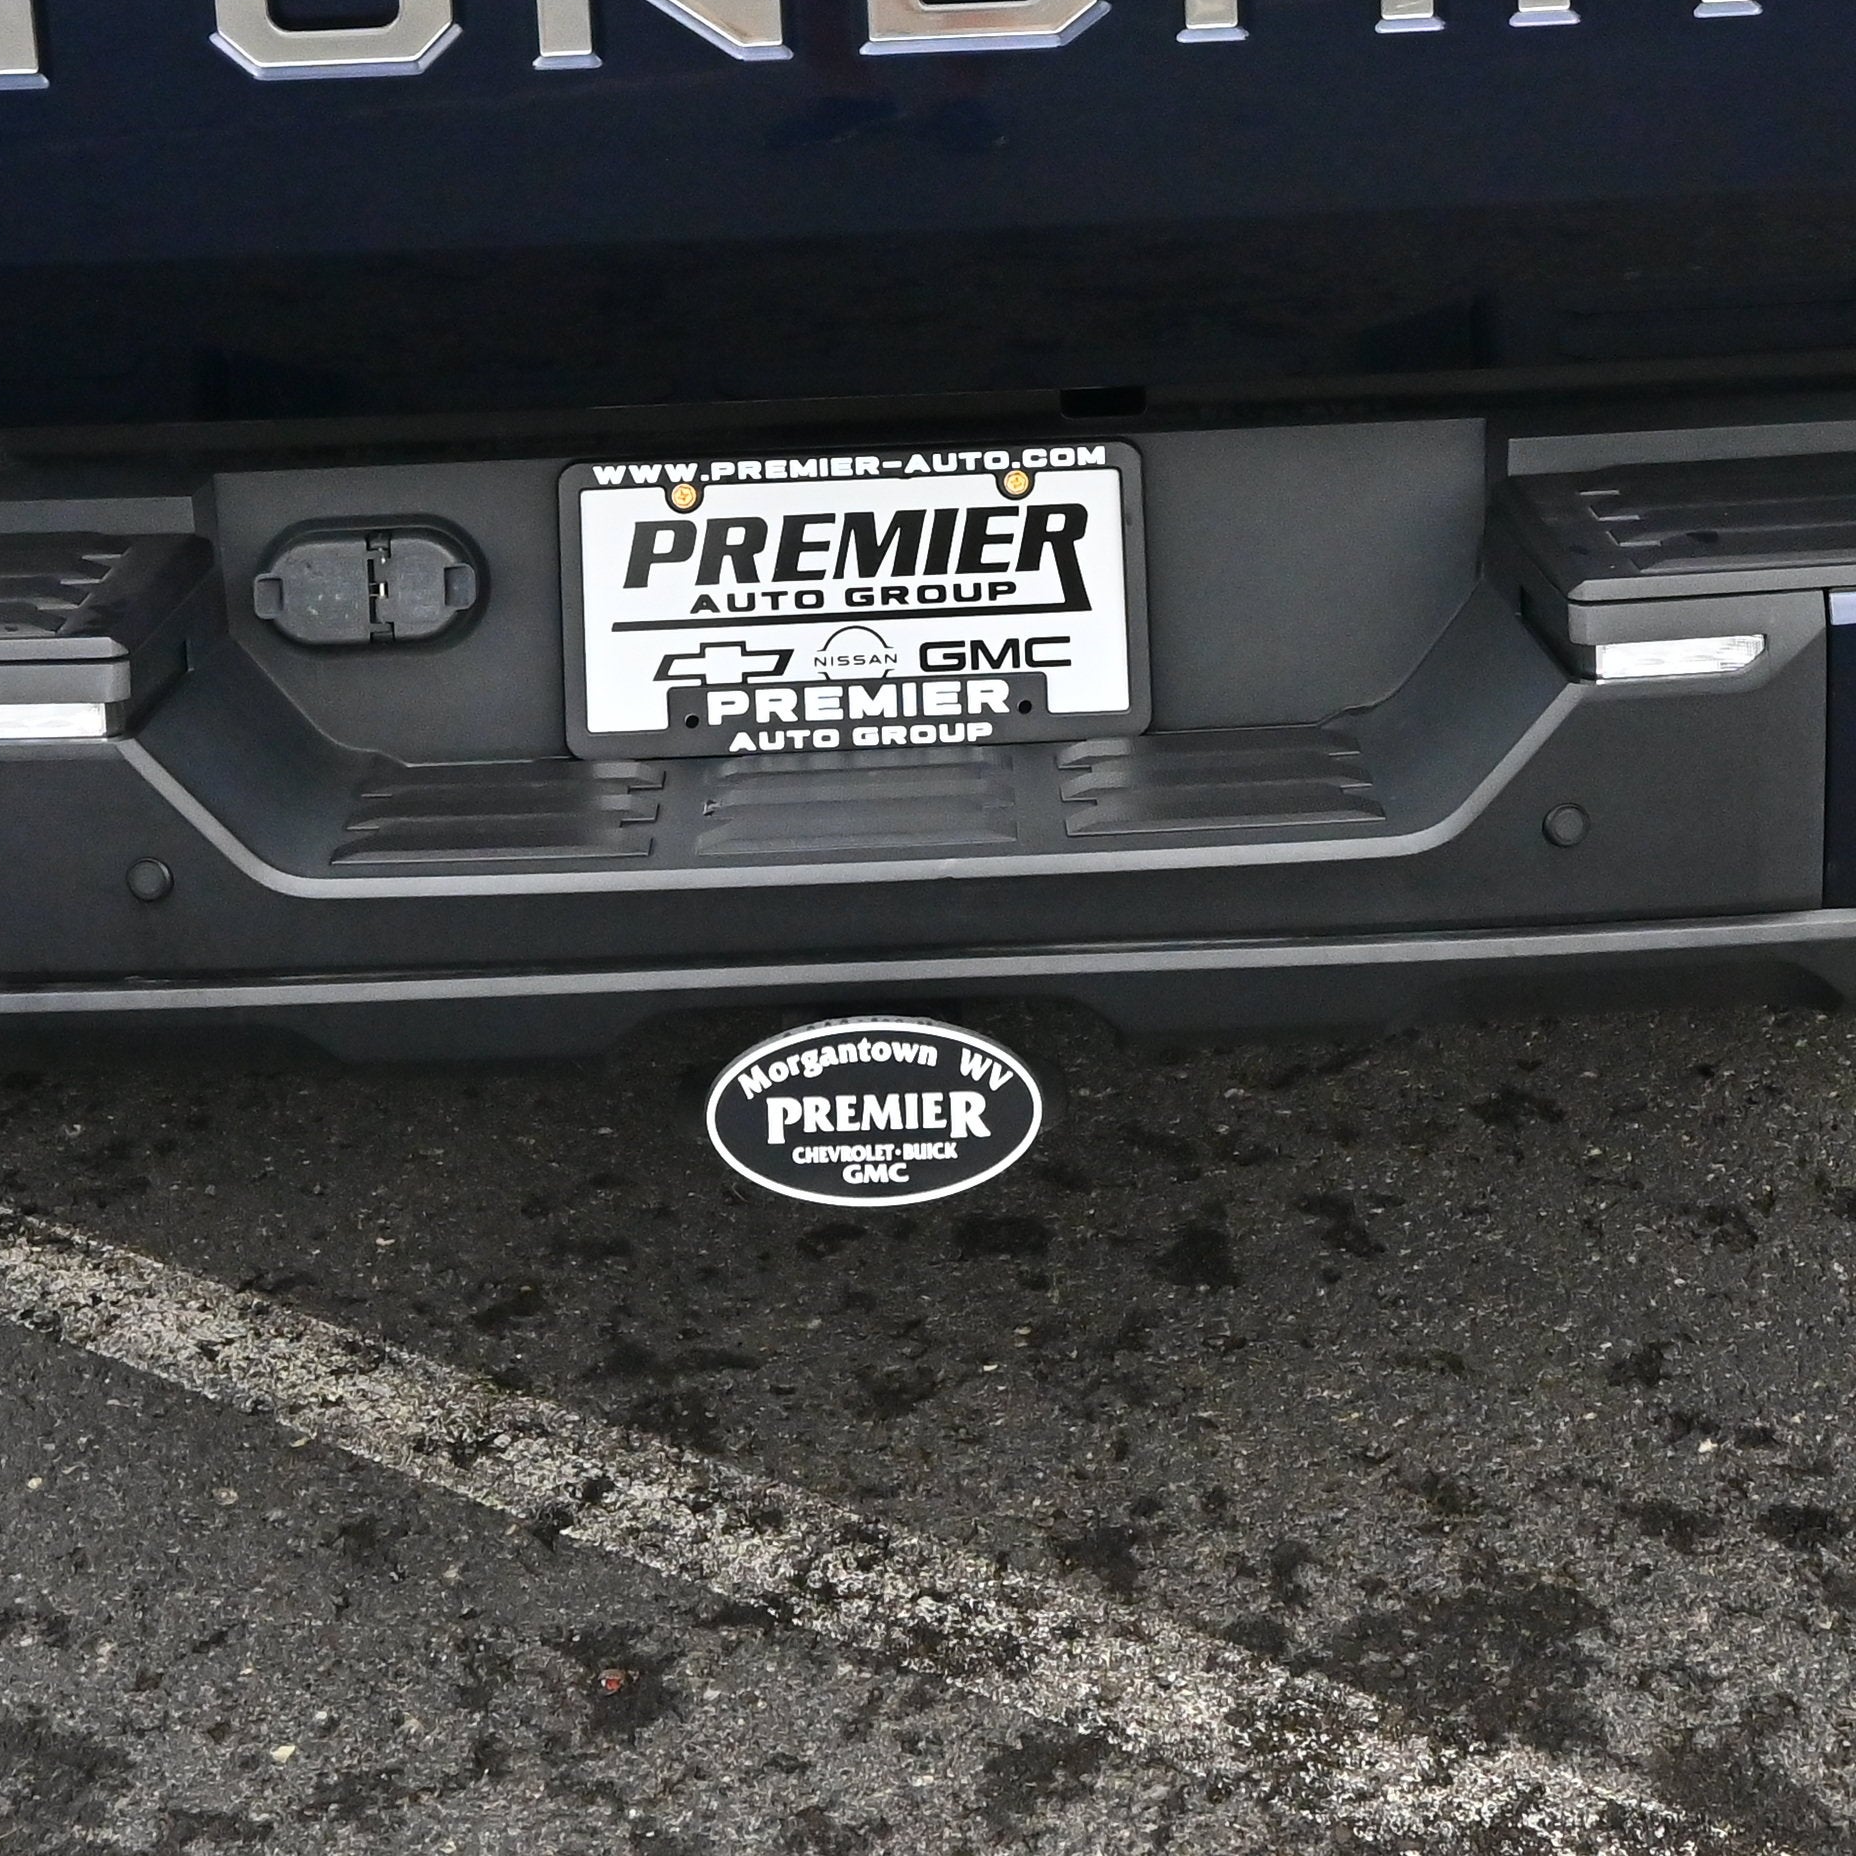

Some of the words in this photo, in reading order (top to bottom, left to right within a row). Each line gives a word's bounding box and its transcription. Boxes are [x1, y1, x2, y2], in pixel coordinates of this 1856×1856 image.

[592, 446, 1106, 485] WWW.PREMIER-AUTO.COM
[623, 503, 1092, 611] PREMIER
[690, 588, 825, 614] AUTO
[844, 581, 1018, 607] GROUP
[813, 653, 897, 667] NISSAN
[919, 636, 1072, 672] GMC
[706, 679, 1011, 726] PREMIER
[728, 728, 841, 753] AUTO
[851, 722, 993, 748] GROUP
[737, 1037, 938, 1100] Morgantown
[959, 1047, 1014, 1092] WV
[765, 1090, 992, 1144] PREMIER
[842, 1162, 910, 1185] GMC
